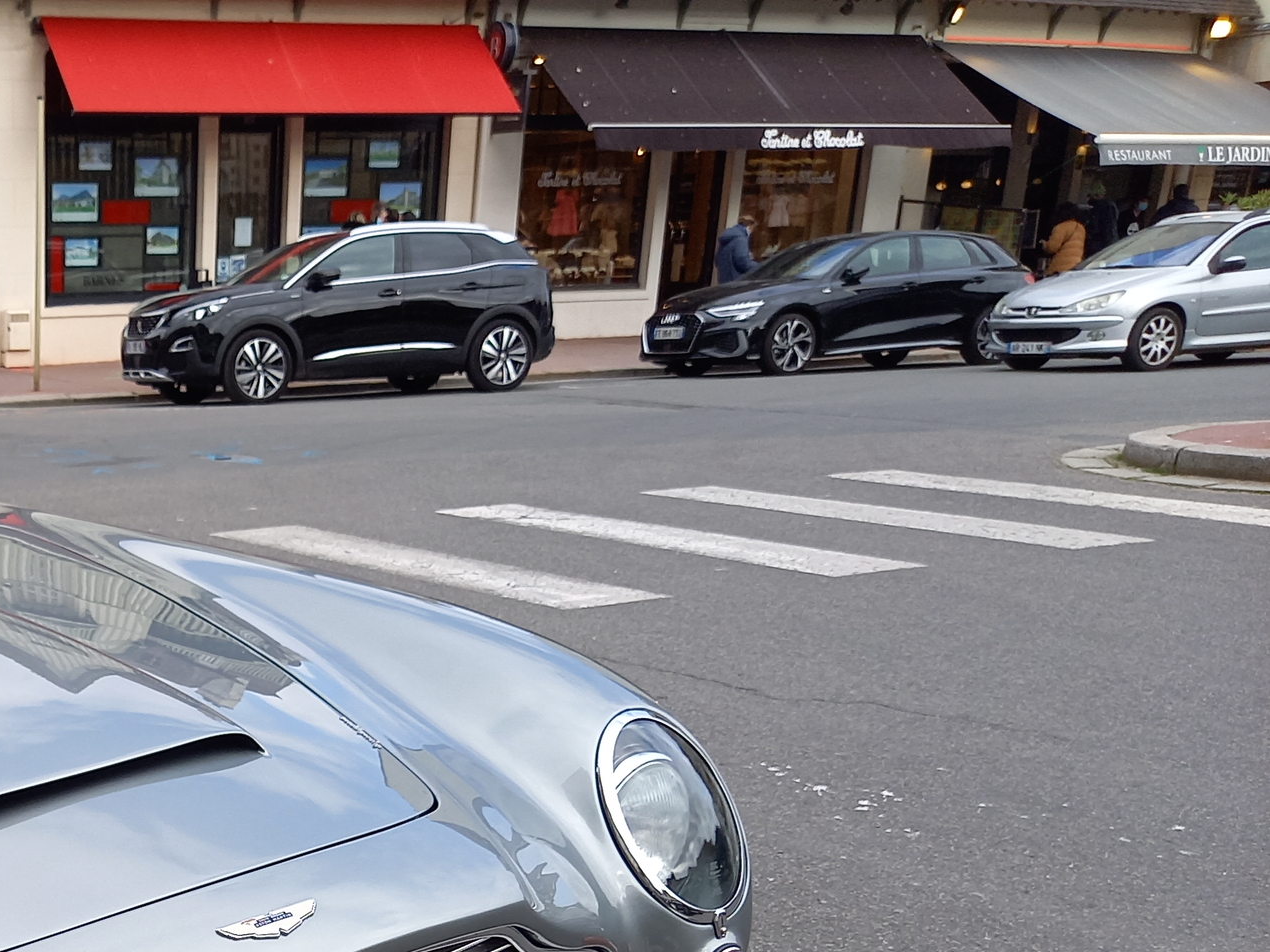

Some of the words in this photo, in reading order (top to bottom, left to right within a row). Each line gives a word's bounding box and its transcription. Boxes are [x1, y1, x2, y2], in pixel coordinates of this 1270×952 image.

[801, 133, 812, 148] et
[813, 129, 865, 148] Chocolat
[1107, 149, 1172, 162] RESTAURANT
[1207, 146, 1225, 162] LE
